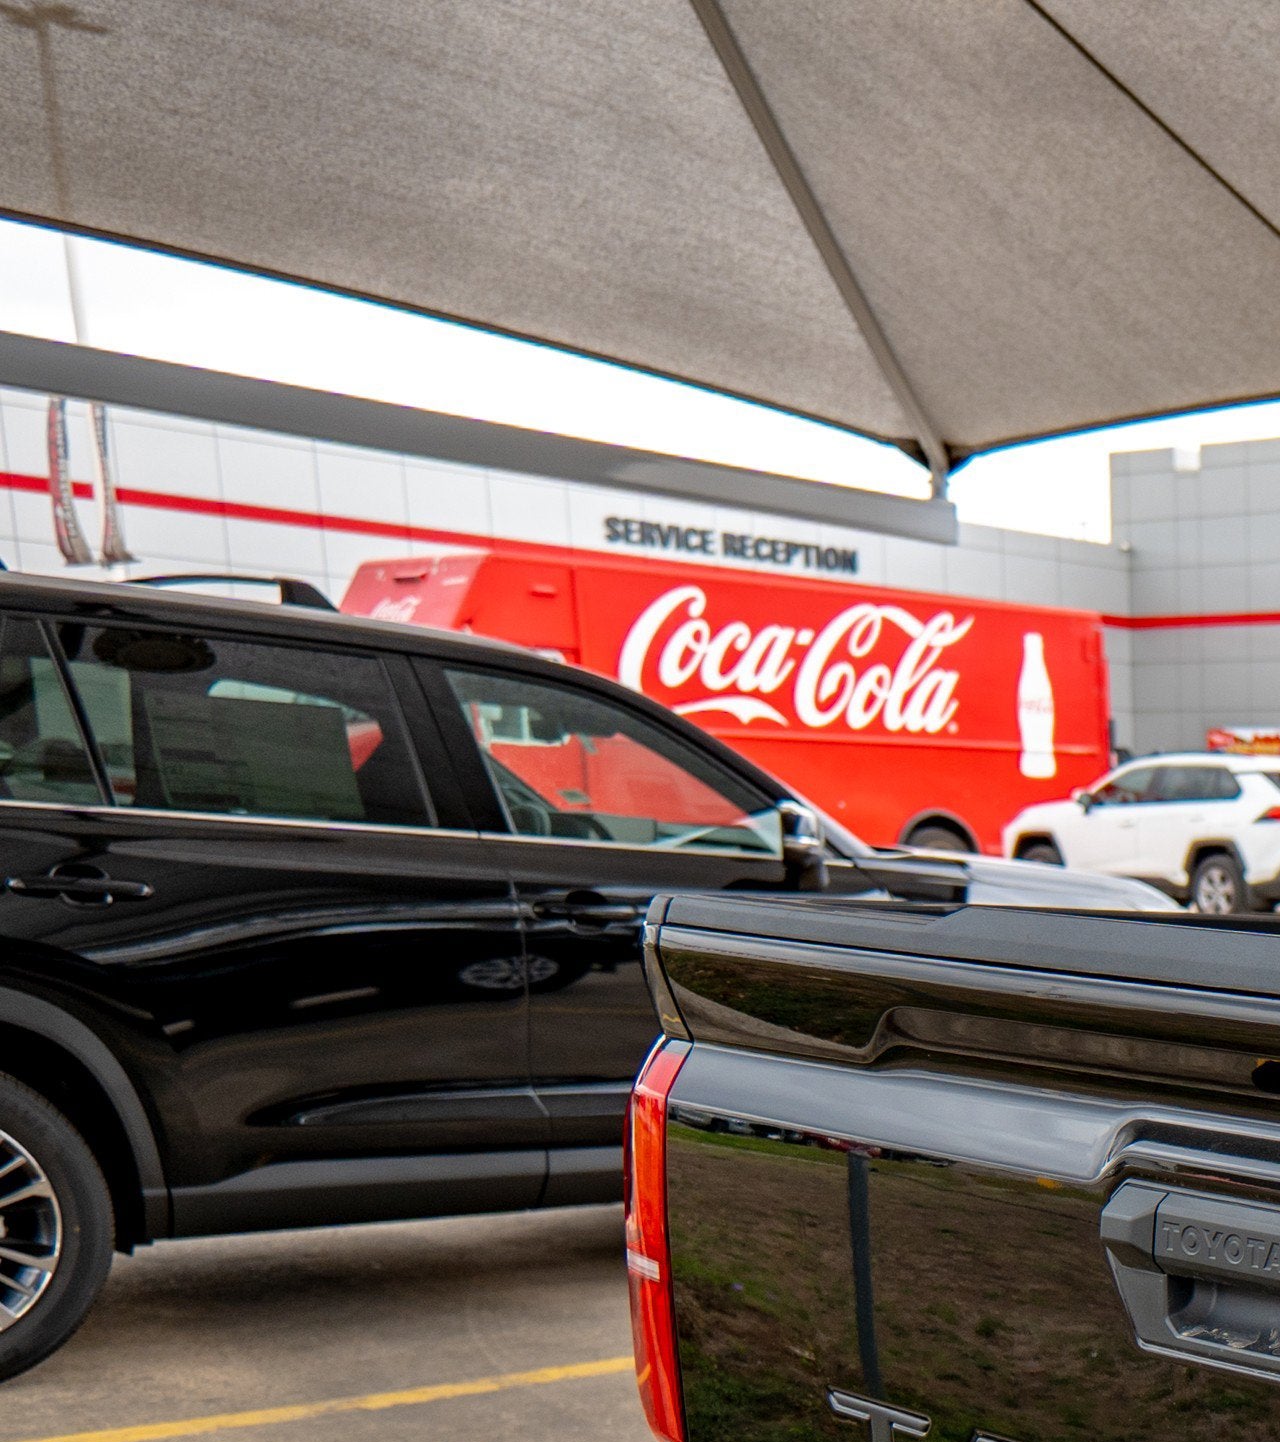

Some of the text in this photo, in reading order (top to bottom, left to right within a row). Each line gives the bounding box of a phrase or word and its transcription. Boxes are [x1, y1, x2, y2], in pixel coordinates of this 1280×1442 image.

[604, 517, 859, 575] SERVICE RECEPTION
[618, 585, 975, 733] Coca-Cola
